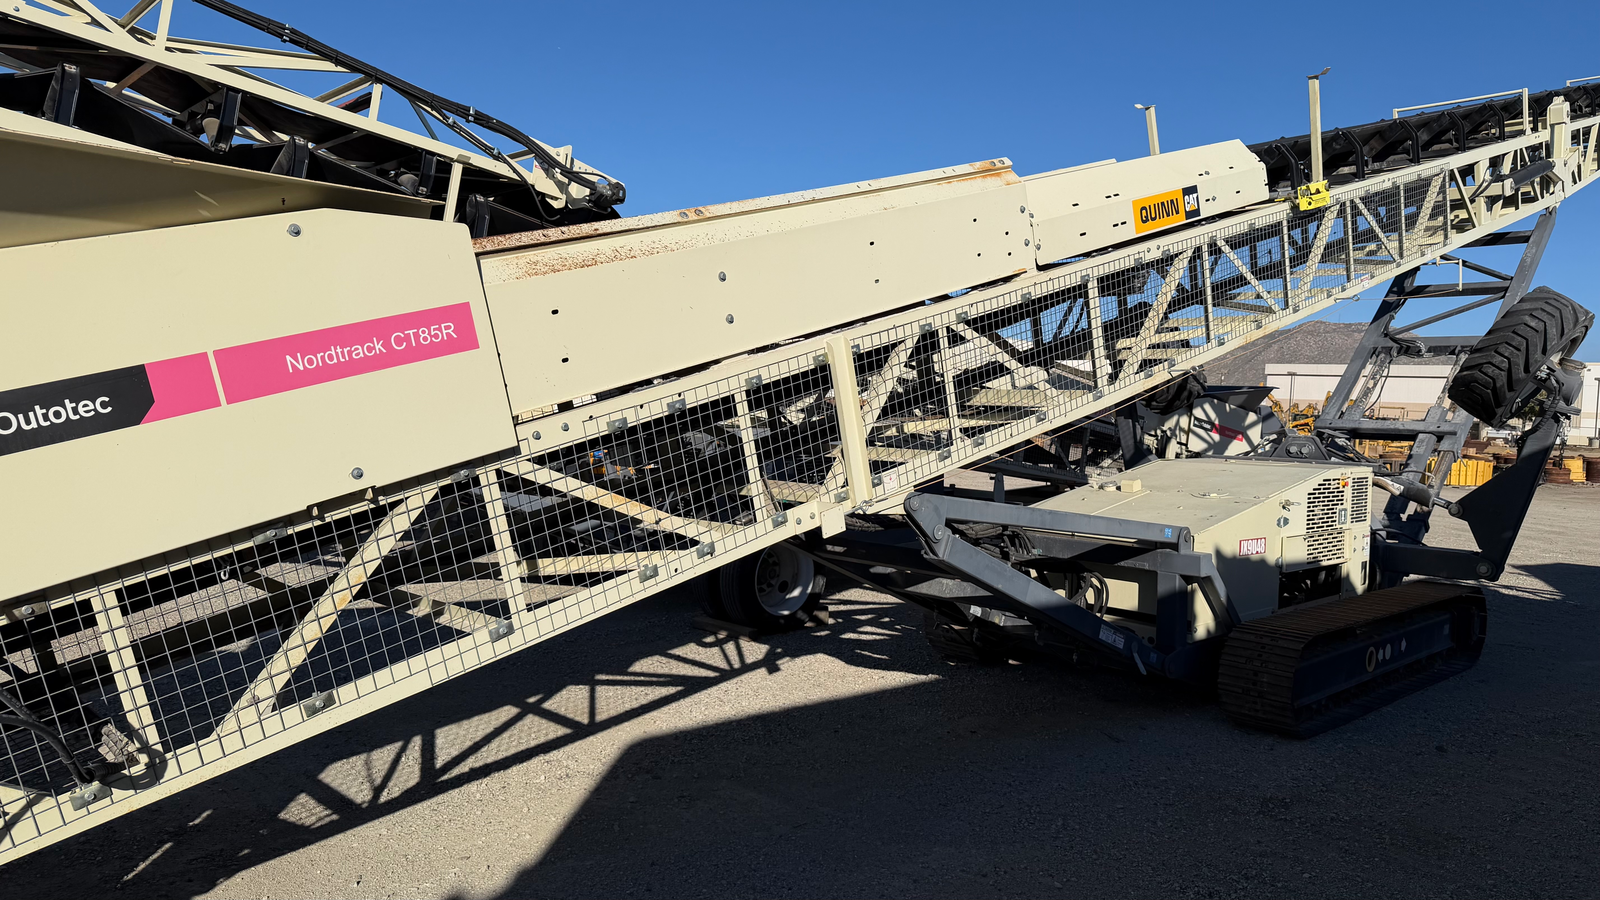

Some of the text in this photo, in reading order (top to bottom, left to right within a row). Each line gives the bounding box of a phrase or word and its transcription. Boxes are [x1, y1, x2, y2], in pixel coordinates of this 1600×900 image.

[1140, 193, 1199, 225] QUINN CAT
[285, 322, 458, 373] Nordtrack CT85R
[0, 396, 113, 435] Outotec
